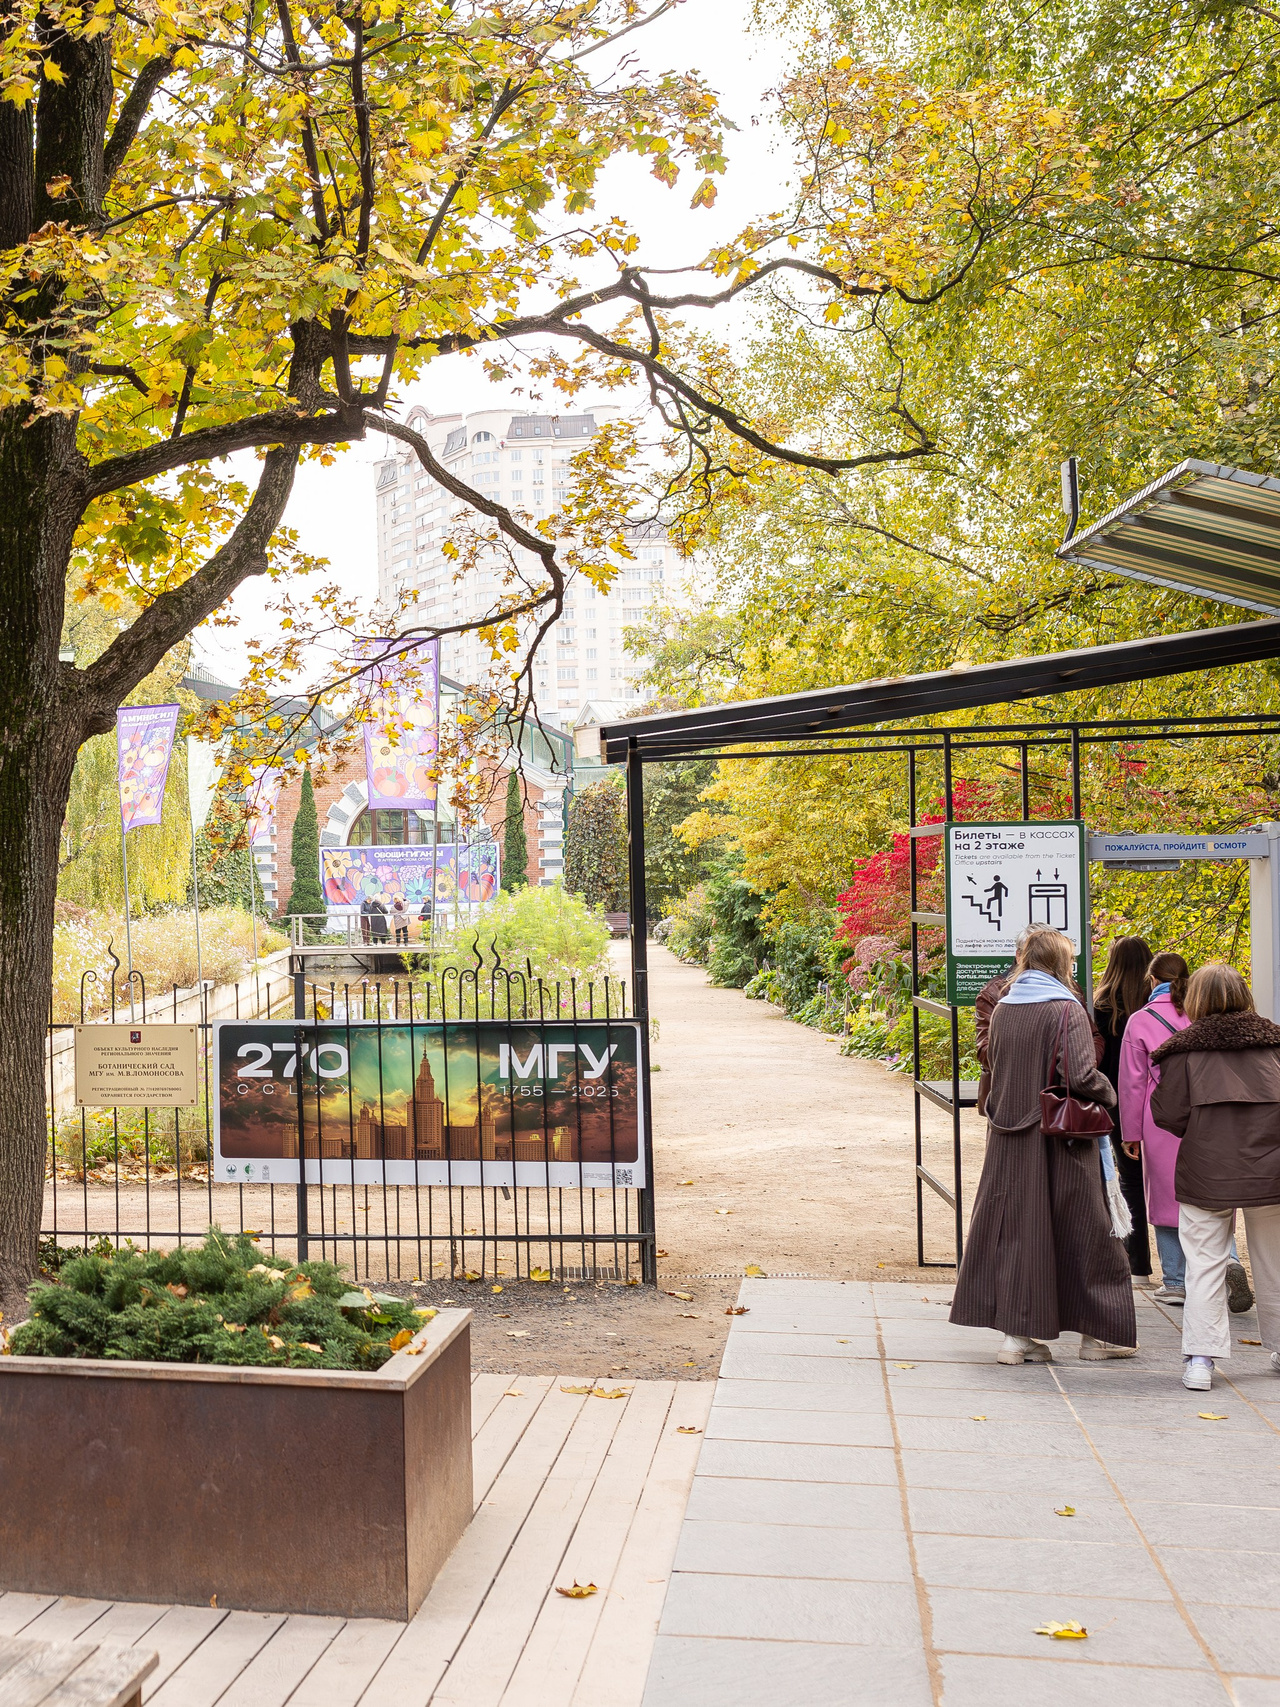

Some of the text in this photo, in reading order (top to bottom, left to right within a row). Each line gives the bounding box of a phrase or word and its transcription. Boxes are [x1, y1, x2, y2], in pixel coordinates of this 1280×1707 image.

[121, 711, 174, 723] АМИНОСИЛ
[954, 830, 1001, 840] Билеты
[1019, 831, 1026, 839] в
[1030, 831, 1075, 839] кассах
[974, 841, 982, 850] 2
[985, 842, 1025, 850] этаже
[1105, 841, 1247, 852] ПОЖАЛУЙСТА, ПРОЙДИТЕ ОСМОТР
[237, 1042, 349, 1079] 270
[499, 1043, 618, 1079] МГУ
[499, 1085, 544, 1097] 1755
[571, 1085, 619, 1097] 2025
